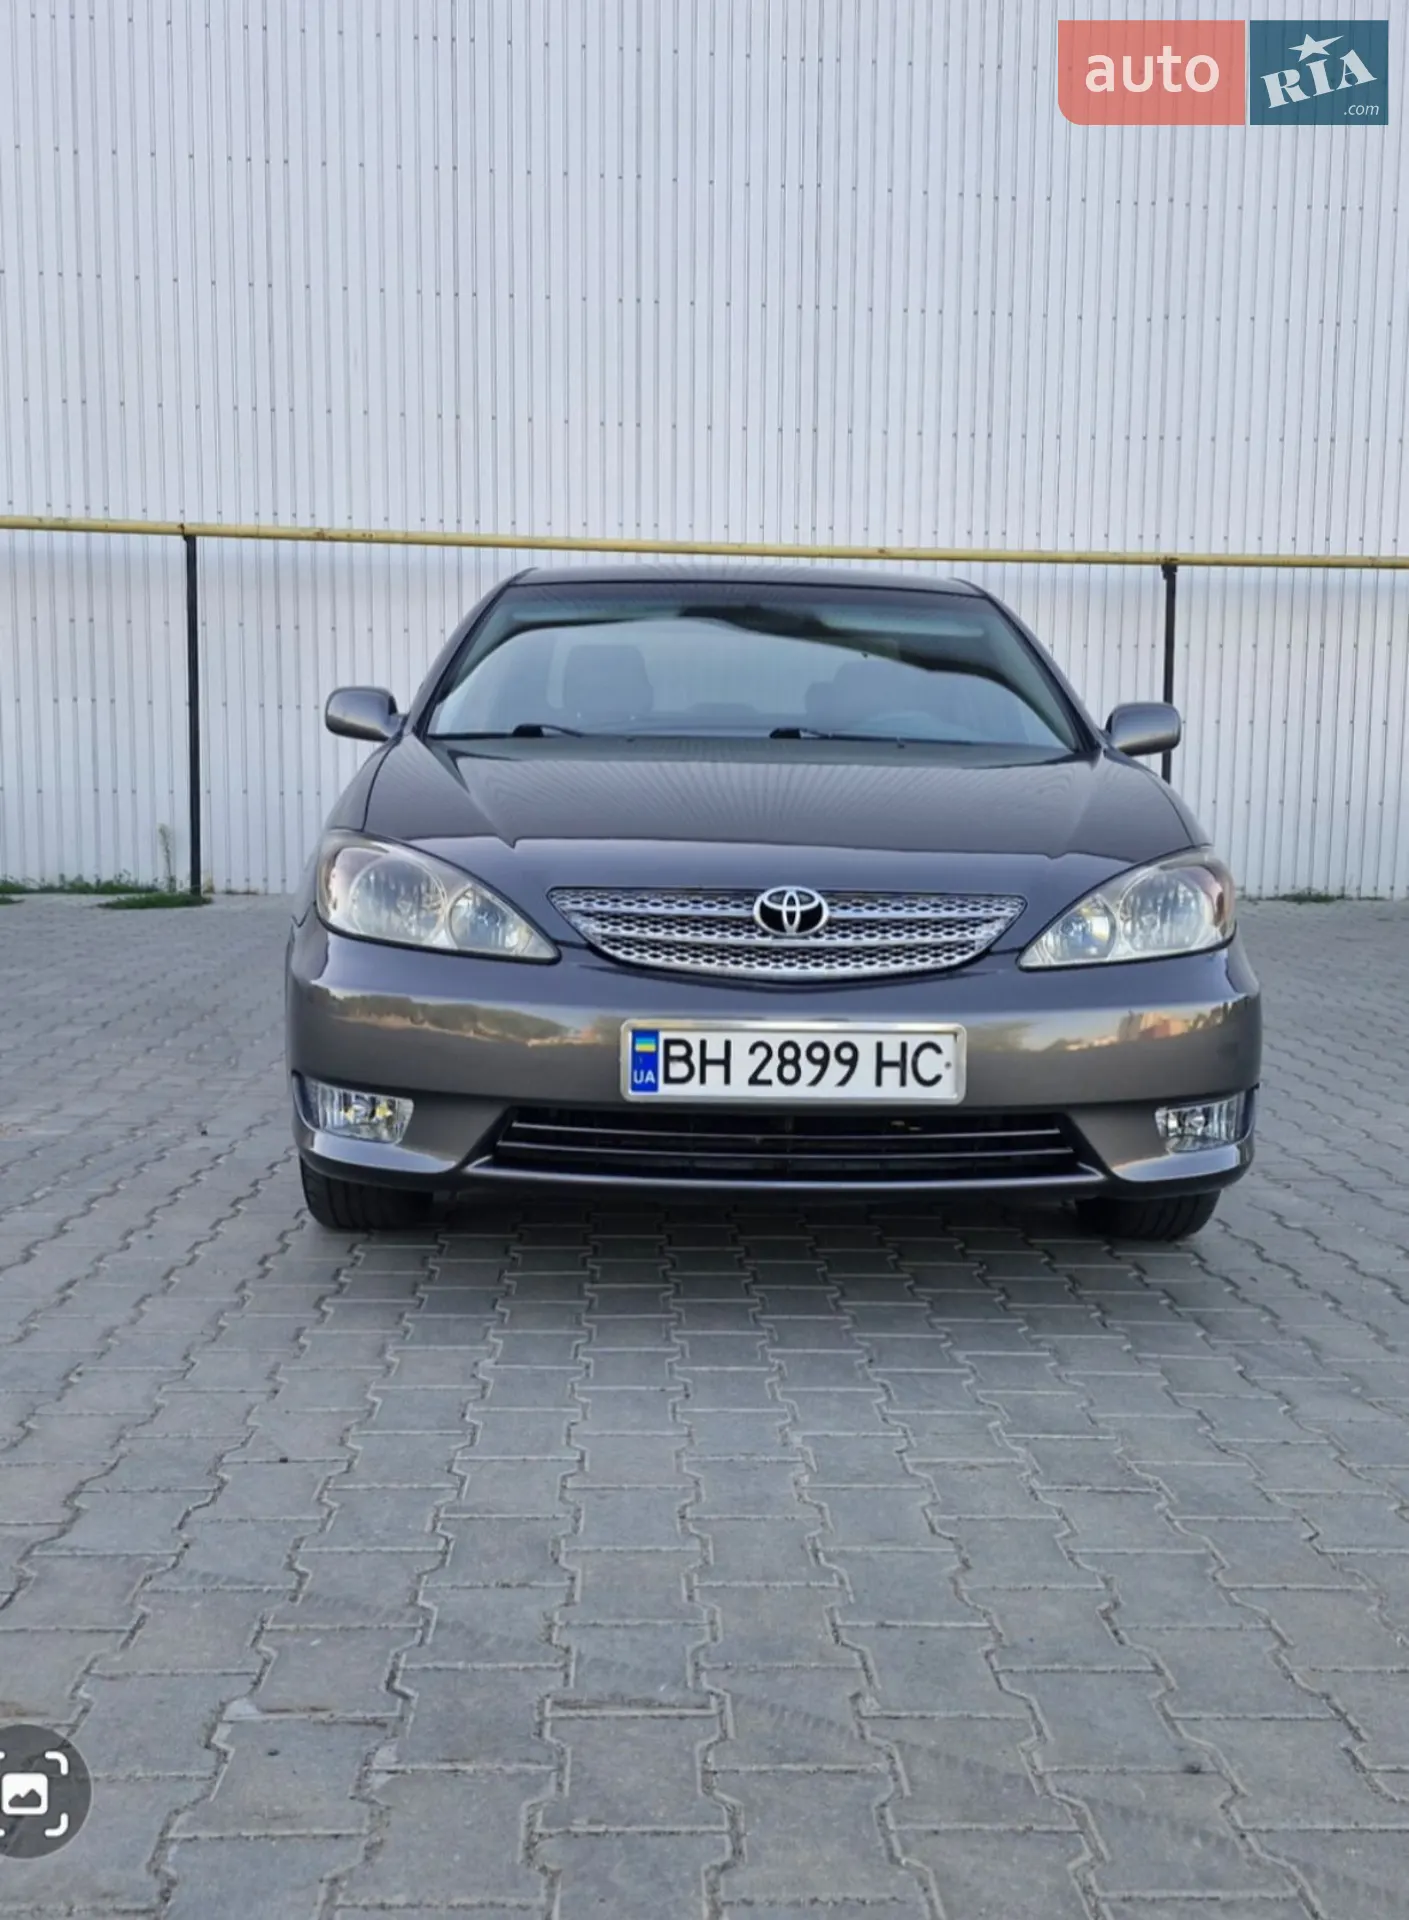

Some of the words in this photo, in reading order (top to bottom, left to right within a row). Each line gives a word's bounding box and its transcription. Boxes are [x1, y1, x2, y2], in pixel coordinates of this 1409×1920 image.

[633, 1069, 656, 1084] UA
[662, 1038, 732, 1085] BH
[748, 1040, 859, 1087] 2899
[875, 1041, 944, 1087] HC
